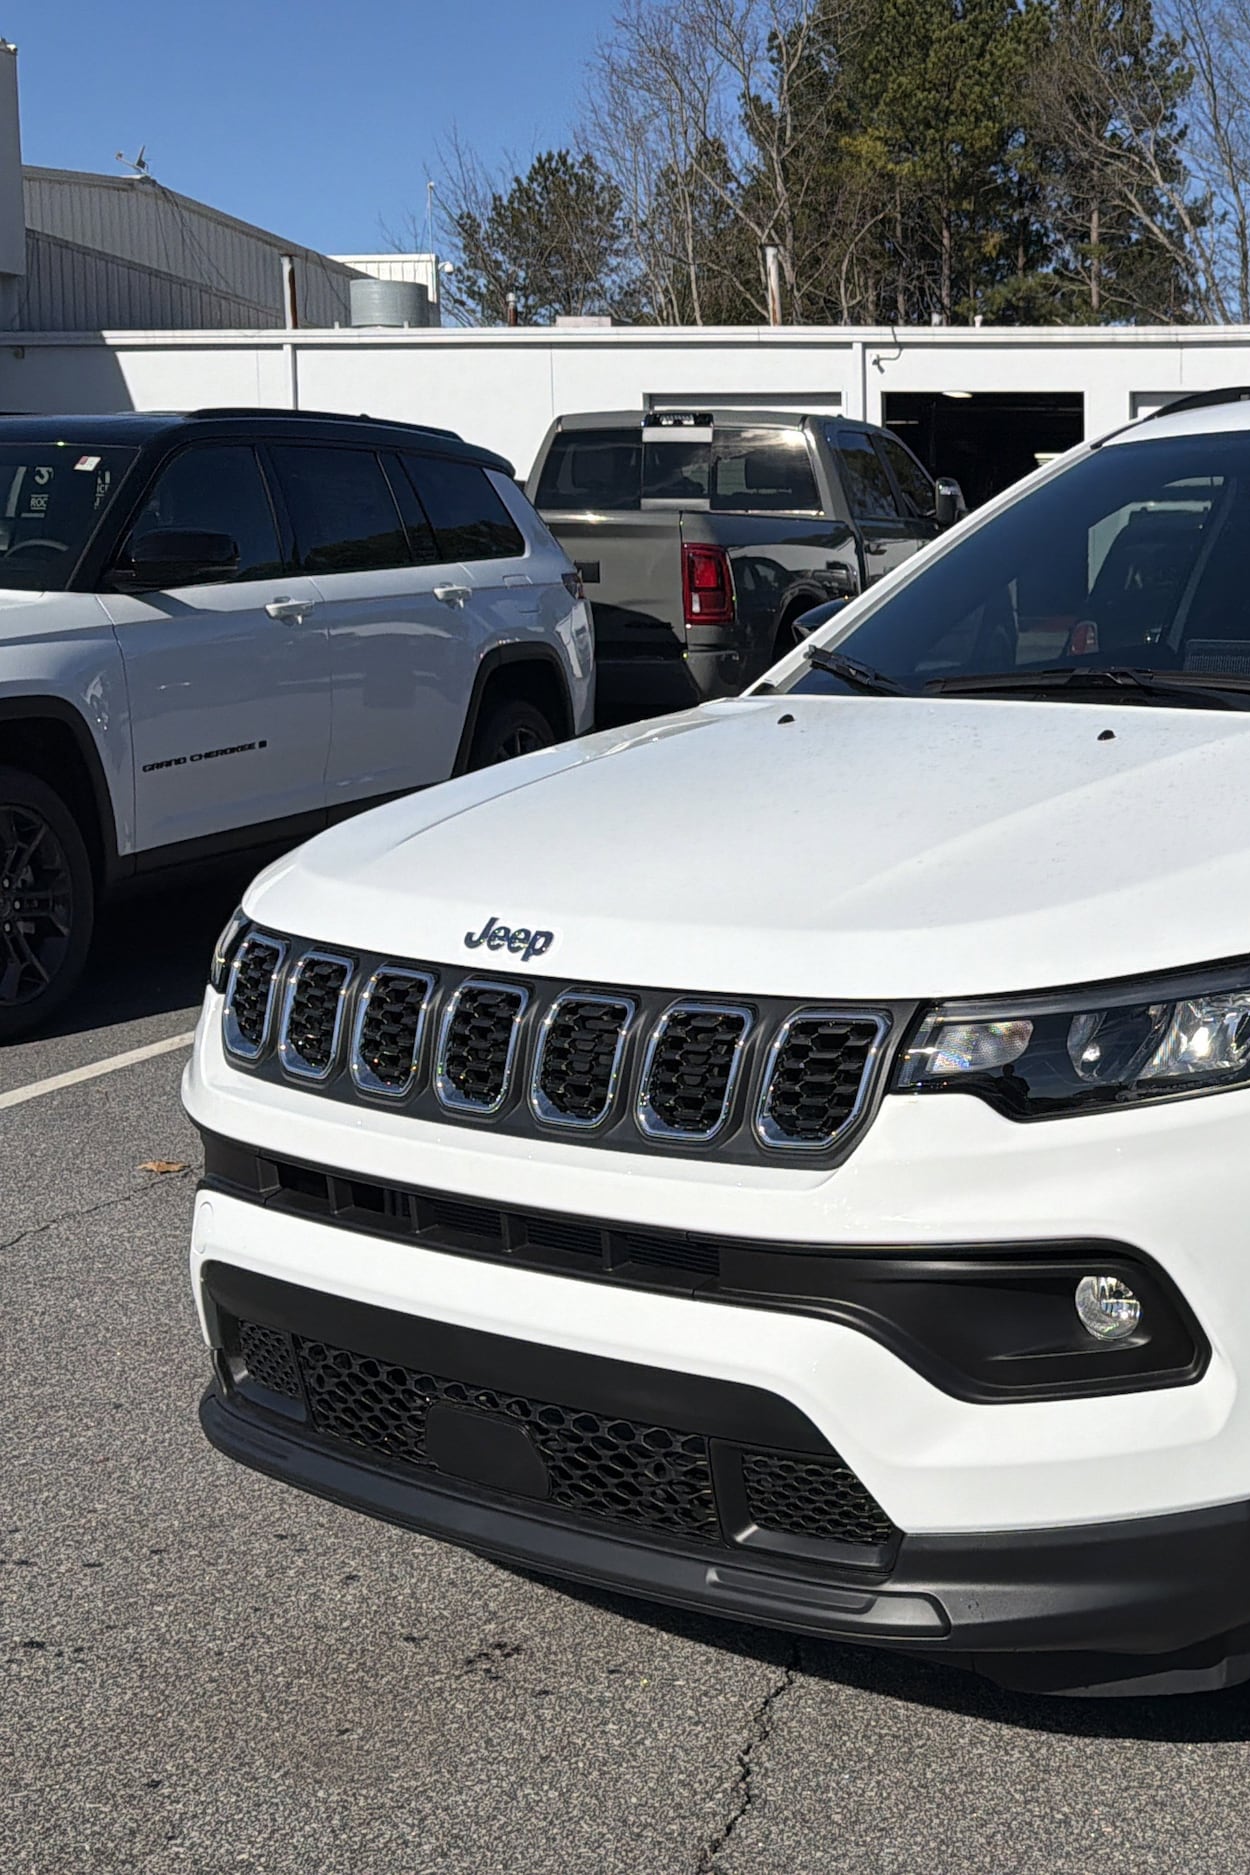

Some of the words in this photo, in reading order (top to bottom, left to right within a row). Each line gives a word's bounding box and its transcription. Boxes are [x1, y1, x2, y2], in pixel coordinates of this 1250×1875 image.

[142, 756, 187, 773] GRAND
[189, 742, 256, 762] CHEROKEE
[463, 916, 554, 962] Jeep
